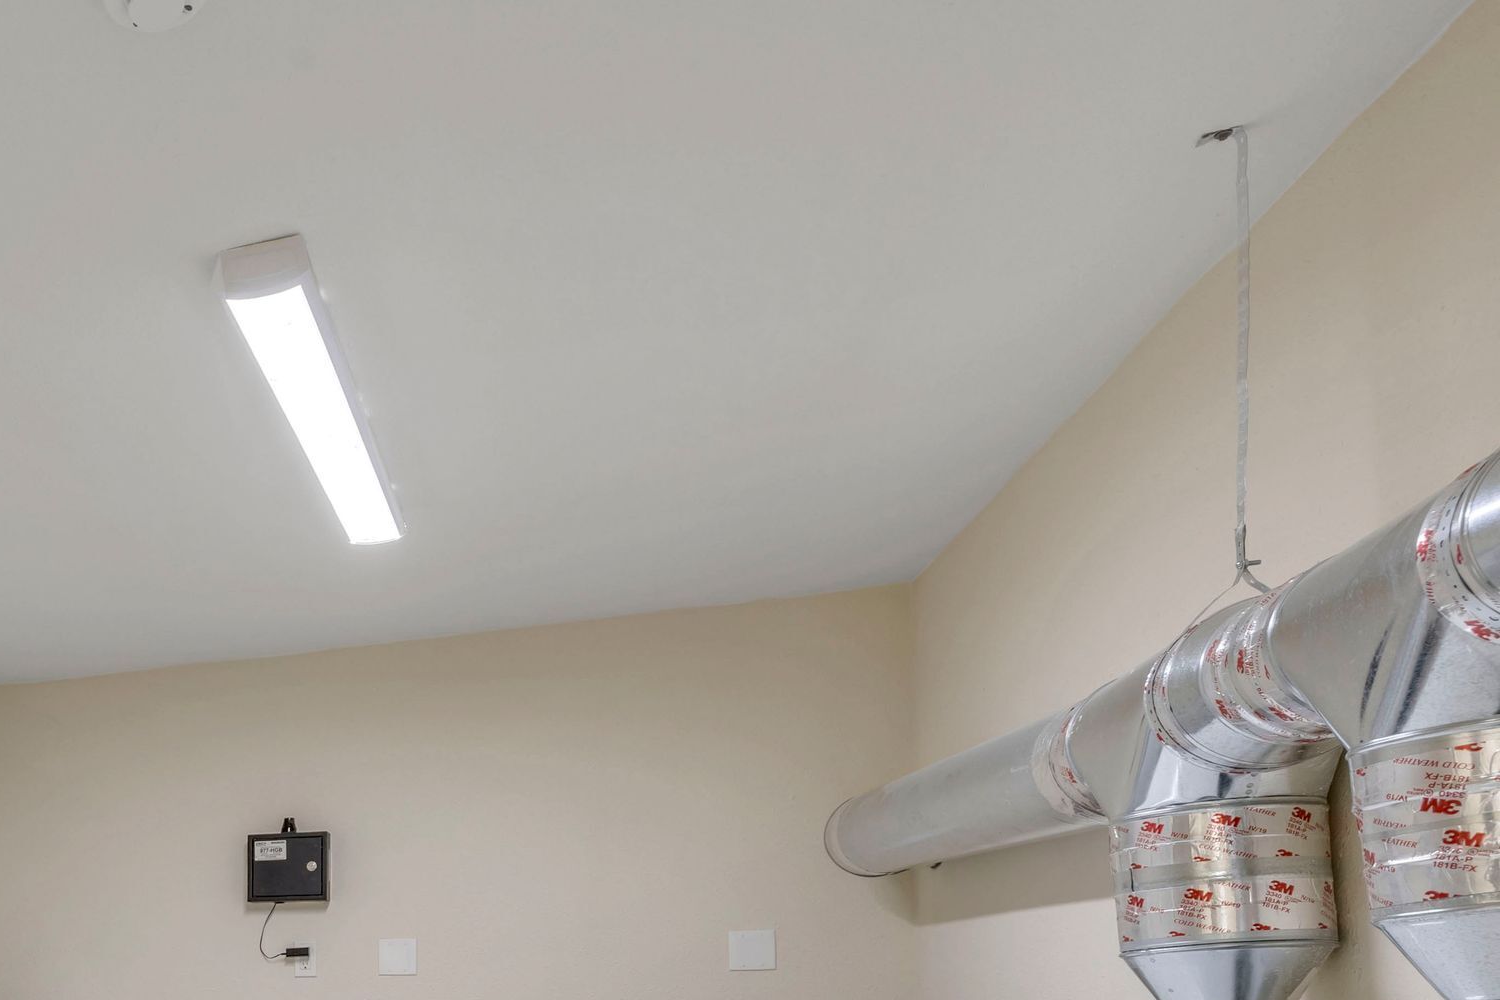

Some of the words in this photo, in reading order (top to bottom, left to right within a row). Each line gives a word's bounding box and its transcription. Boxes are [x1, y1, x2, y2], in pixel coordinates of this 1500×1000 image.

[1425, 772, 1470, 783] 181B-FX
[1420, 798, 1462, 815] 3M
[1211, 813, 1241, 827] 3M
[1291, 806, 1312, 823] 3M
[1141, 821, 1164, 834] 3M
[1381, 838, 1418, 849] EATHER
[1442, 829, 1485, 847] 3M
[1434, 854, 1473, 862] 181A-P
[1433, 861, 1477, 872] 181B-FX
[1269, 880, 1295, 895] 3M
[1127, 895, 1145, 908] 3M
[1184, 888, 1213, 902] 3M
